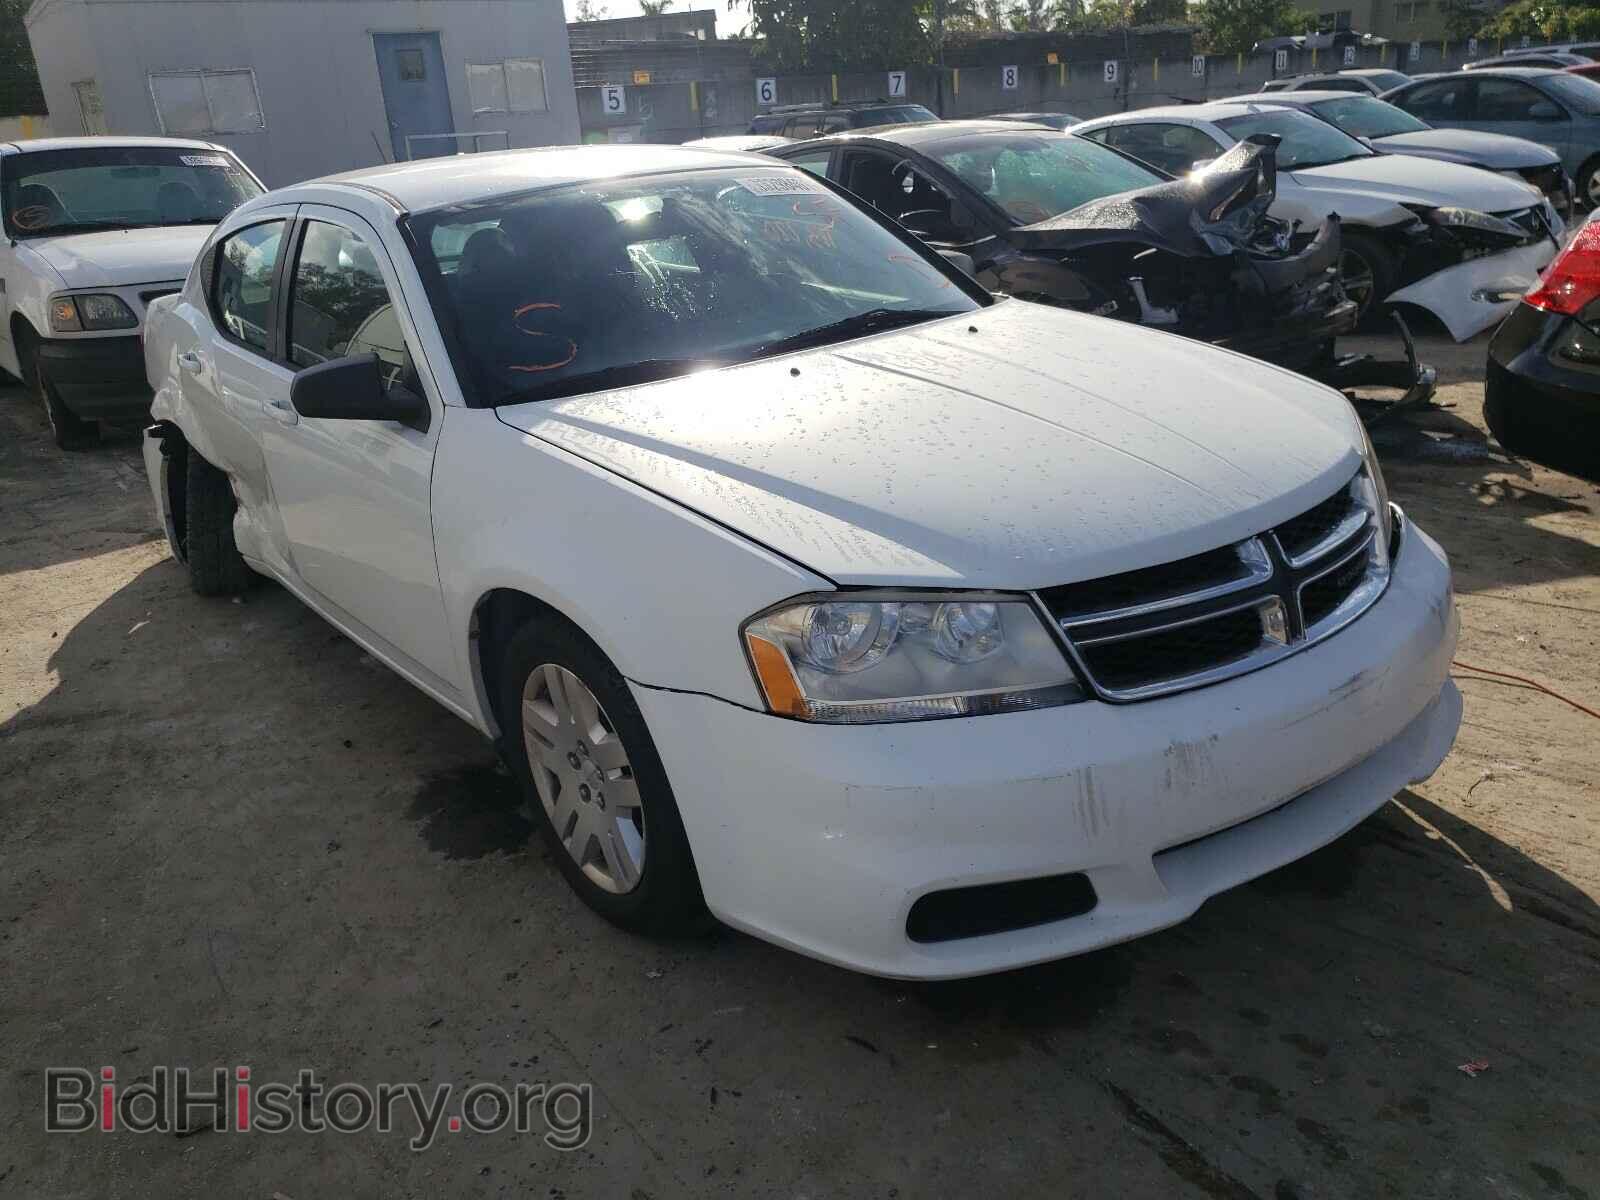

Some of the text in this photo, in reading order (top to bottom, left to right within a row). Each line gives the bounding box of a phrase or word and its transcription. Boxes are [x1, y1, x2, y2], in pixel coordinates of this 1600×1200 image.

[1194, 57, 1203, 74] 10
[1277, 53, 1286, 69] 11
[1006, 69, 1015, 86] 8
[1107, 64, 1114, 80] 9
[761, 81, 772, 101] 6
[892, 75, 901, 94] 7
[608, 89, 620, 111] 5
